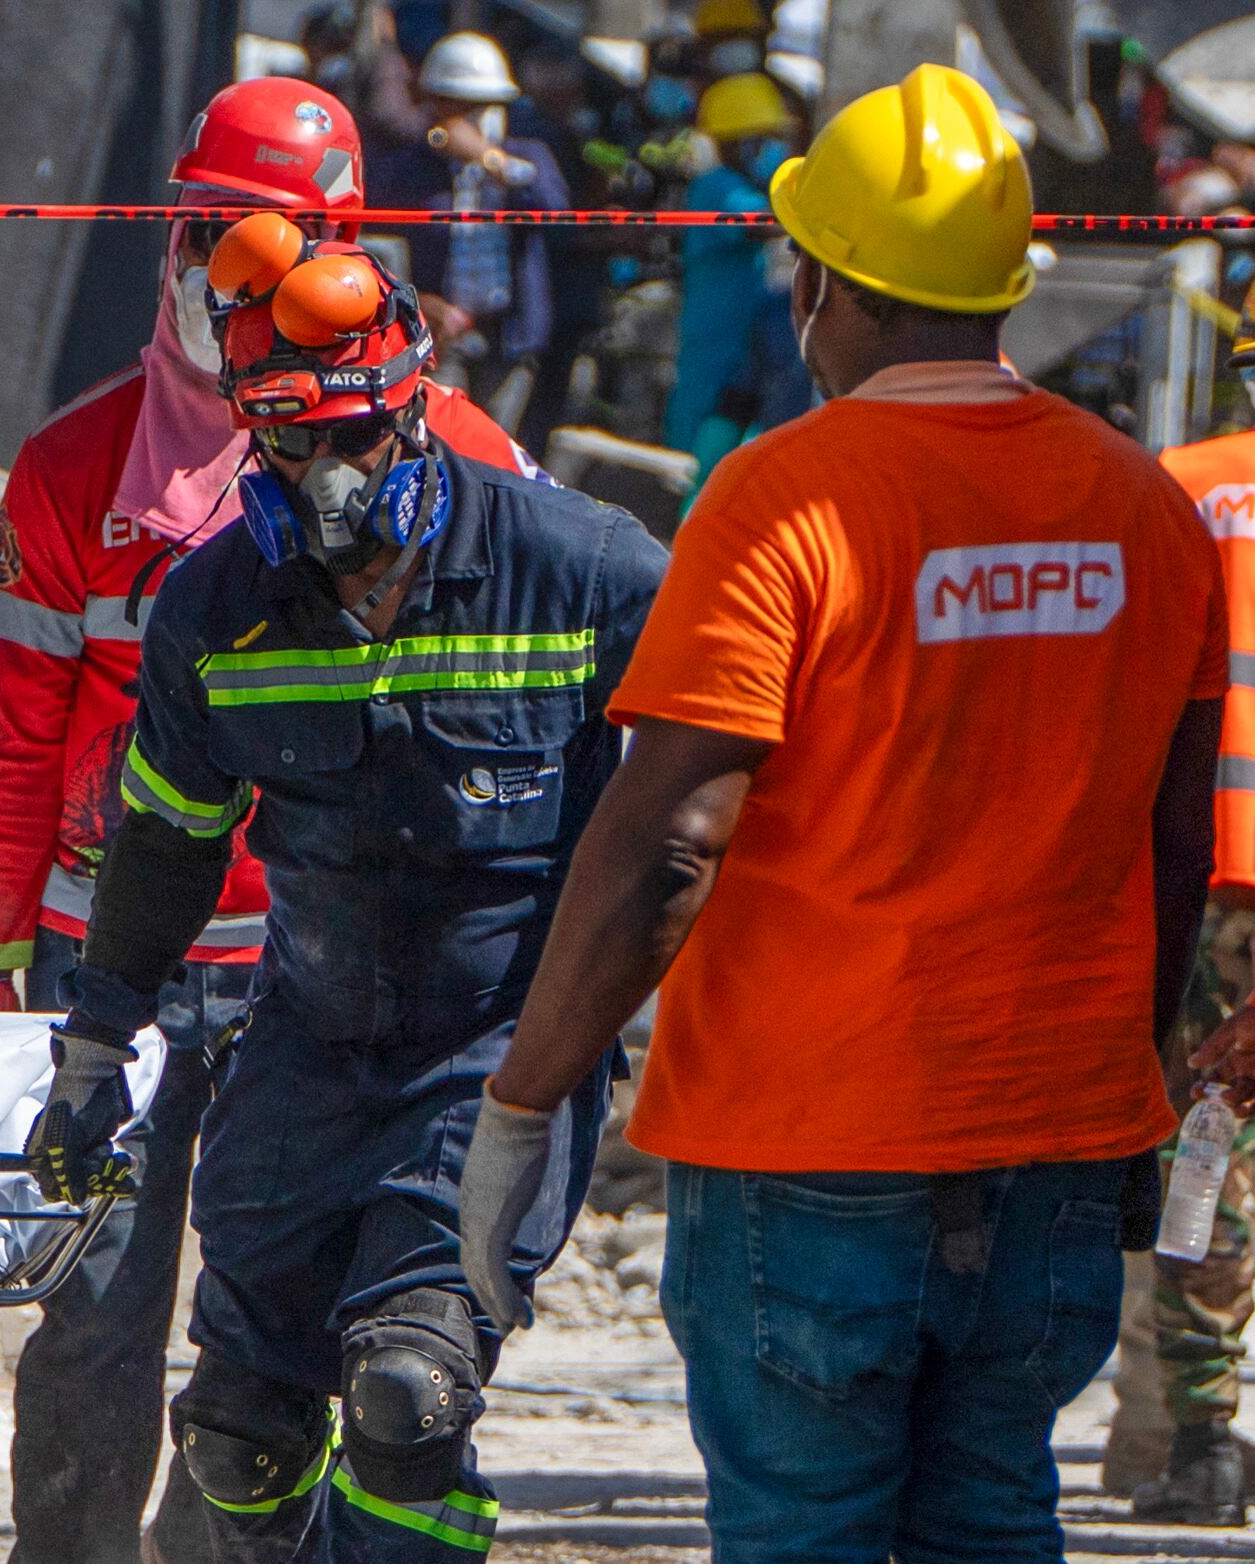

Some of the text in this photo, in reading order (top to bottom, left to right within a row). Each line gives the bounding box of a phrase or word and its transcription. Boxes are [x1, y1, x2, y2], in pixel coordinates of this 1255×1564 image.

[935, 560, 1112, 618] MOPC
[498, 782, 530, 794] Punta
[499, 789, 543, 803] Catalina
